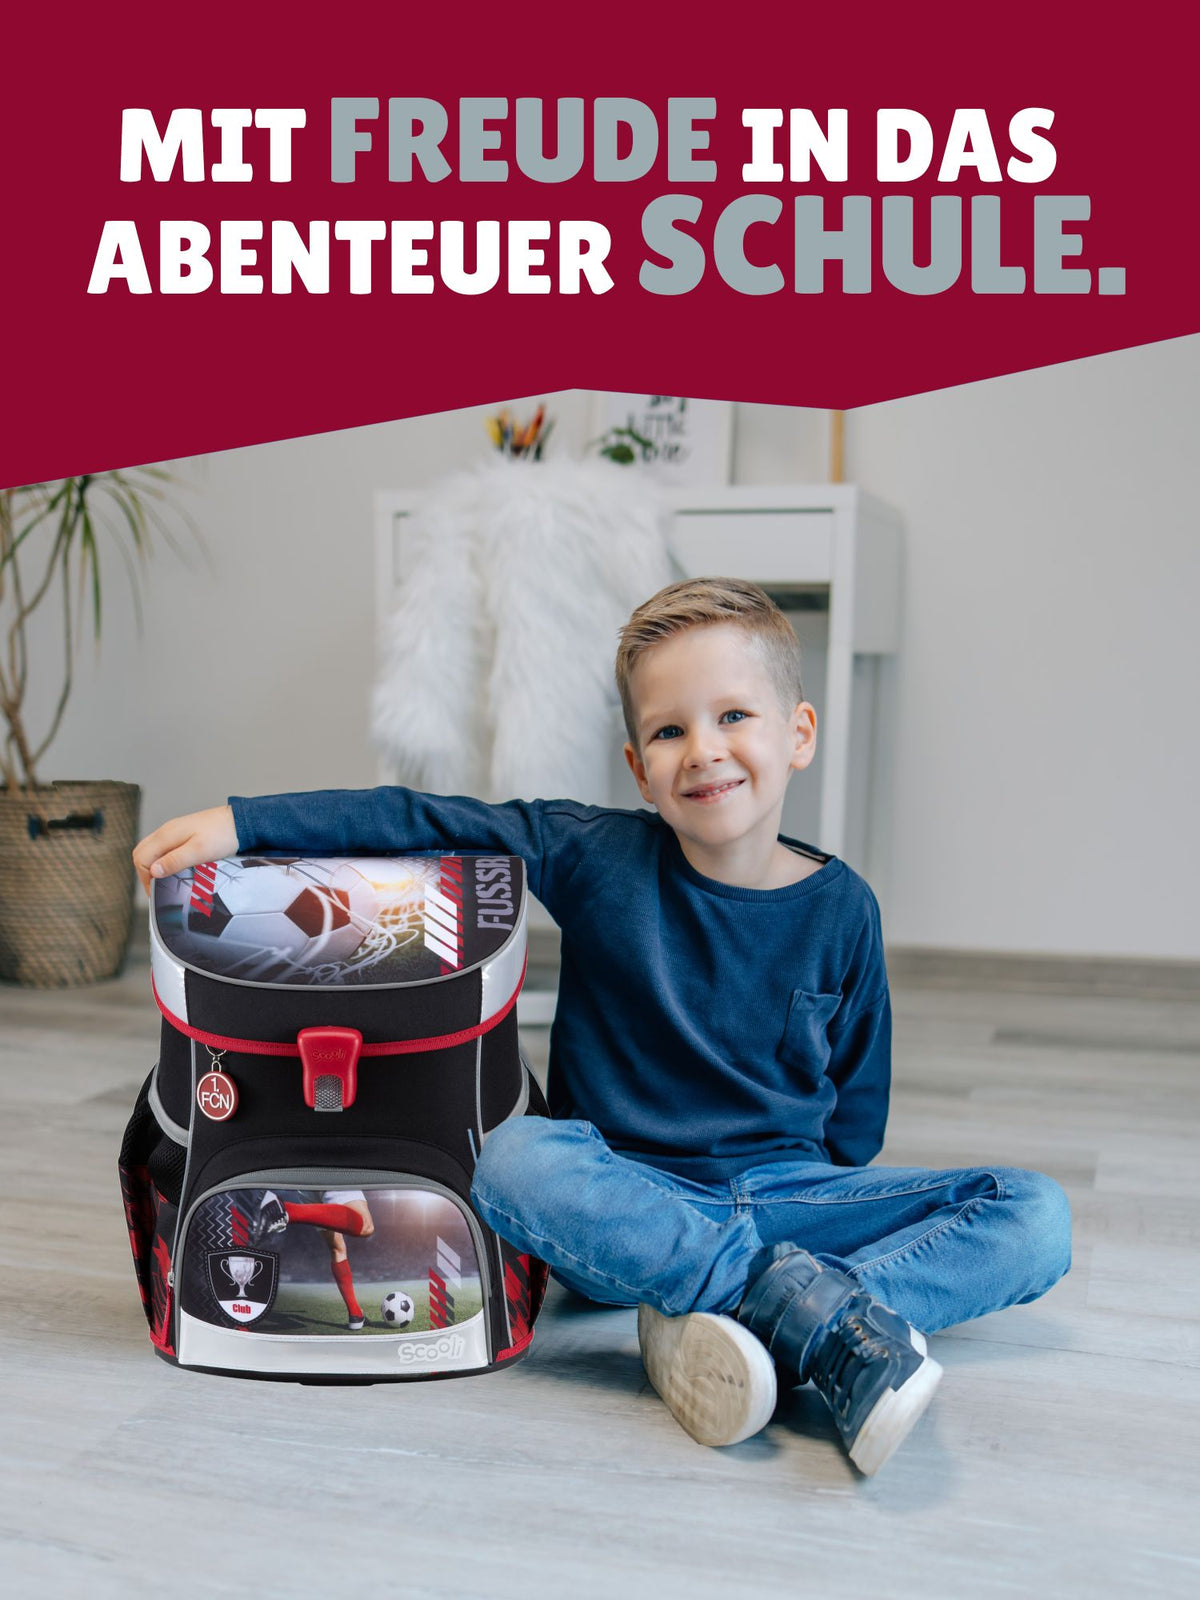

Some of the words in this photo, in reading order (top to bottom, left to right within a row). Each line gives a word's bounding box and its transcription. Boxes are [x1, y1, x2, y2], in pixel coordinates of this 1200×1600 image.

[211, 1077, 219, 1092] 1.
[201, 1091, 230, 1110] FCN
[232, 1303, 251, 1315] Club
